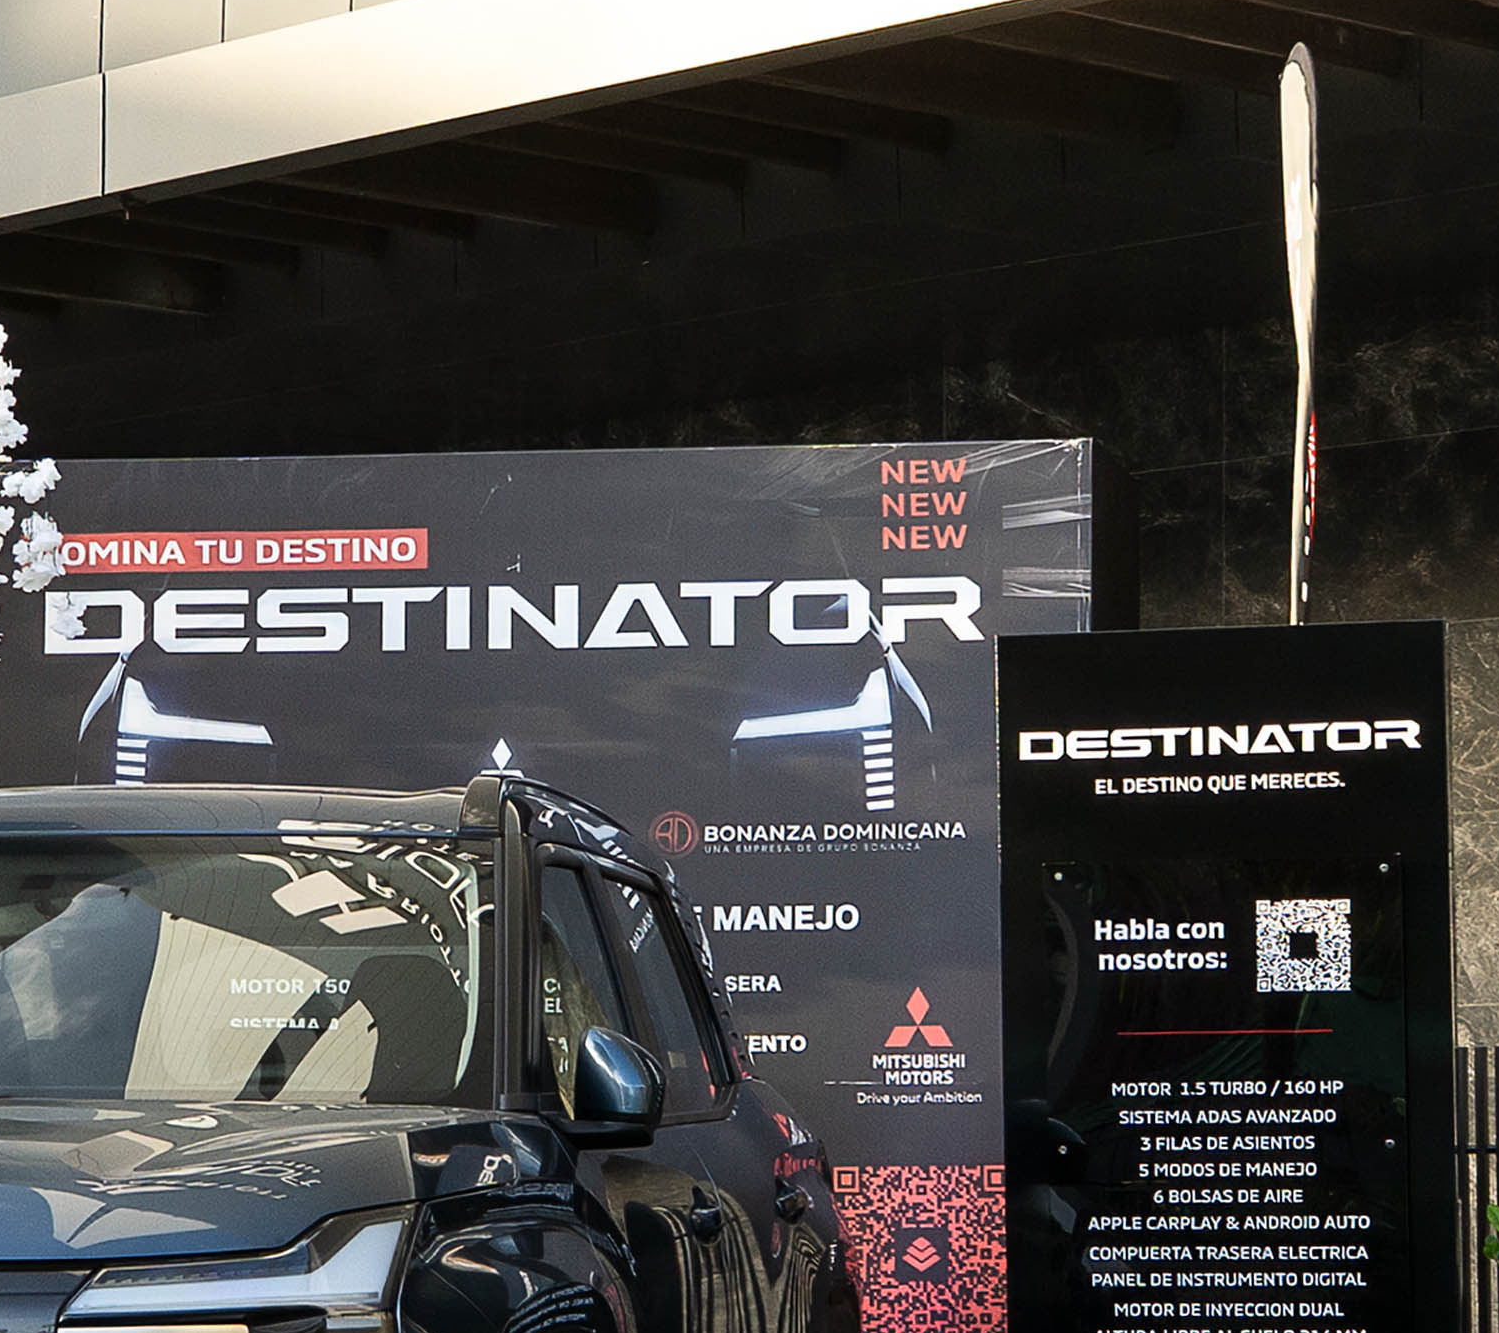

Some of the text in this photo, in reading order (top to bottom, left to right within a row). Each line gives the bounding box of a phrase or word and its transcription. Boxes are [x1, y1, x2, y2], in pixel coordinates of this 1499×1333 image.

[880, 458, 967, 484] NEW
[881, 490, 967, 518] NEW
[881, 524, 968, 551] NEW
[59, 537, 416, 566] OMINA TU DESTINO
[44, 578, 985, 655] DESTINATOR
[1019, 719, 1422, 761] DESTINATOR
[1095, 771, 1346, 795] EL DESTINO QUE MERECES.
[704, 821, 966, 842] BONANZA DOMINICANA
[704, 844, 729, 854] UNA
[713, 904, 859, 931] MANEJO
[1094, 918, 1225, 941] Habla con
[1098, 948, 1227, 971] nosotros:
[230, 978, 304, 995] MOTOR
[724, 974, 782, 993] SERA
[746, 1034, 807, 1053] ENTO
[872, 1053, 966, 1069] MITSUBISHI
[885, 1069, 954, 1085] MOTORS
[1111, 1079, 1344, 1097] MOTOR 1.5 TURBO / 160 HP
[856, 1091, 983, 1107] Drive your Ambition
[1119, 1108, 1337, 1125] SISTEMA ADAS AVANZADO
[1140, 1135, 1316, 1151] 3 FILAS DE ASIENTOS
[1139, 1162, 1318, 1178] 5 MODOS DE MANEJO
[1153, 1189, 1304, 1204] 6 BOLSAS DE AIRE
[1088, 1215, 1371, 1231] APPLE CARPLAY & ANDROID AUTO
[1089, 1245, 1369, 1261] COMPUERTA TRASERA ELECTRICA
[1091, 1272, 1367, 1287] PANEL DE INSTRUMENTO DIGITAL
[1114, 1302, 1345, 1317] MOTOR DE INYECCION DUAL
